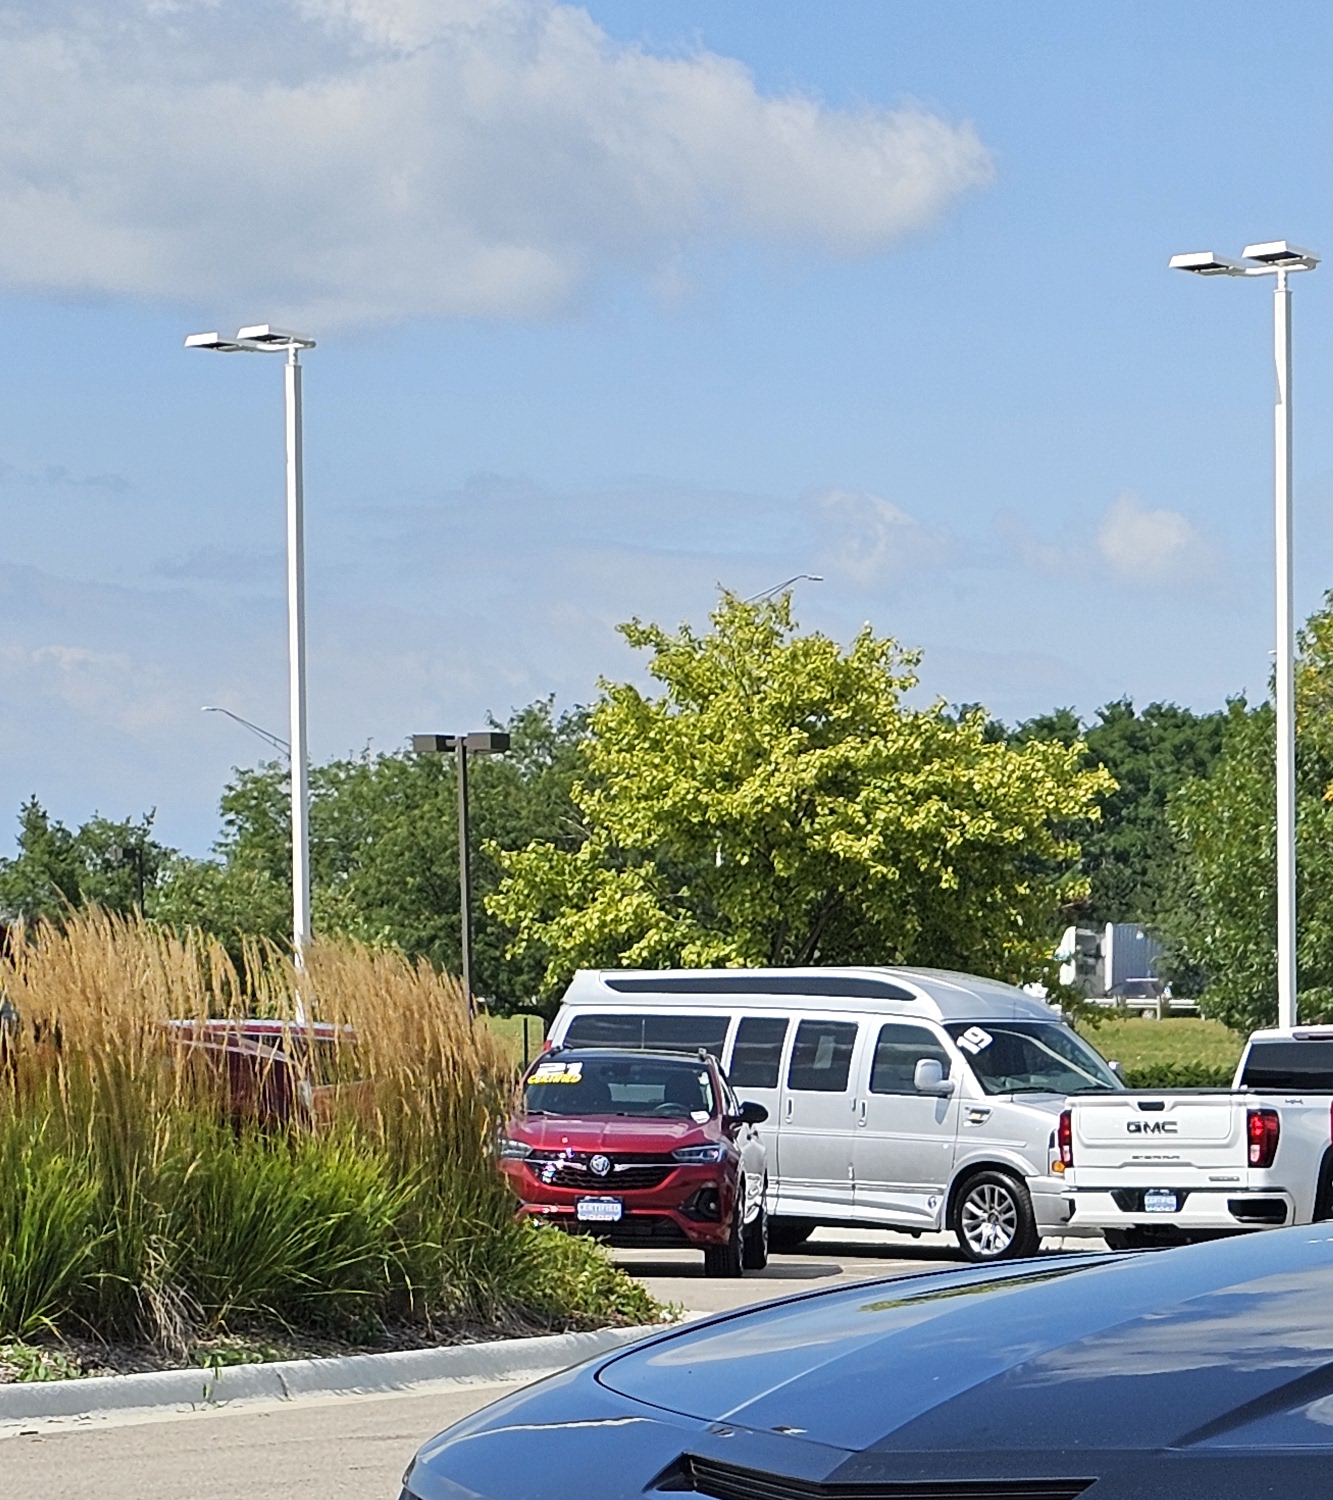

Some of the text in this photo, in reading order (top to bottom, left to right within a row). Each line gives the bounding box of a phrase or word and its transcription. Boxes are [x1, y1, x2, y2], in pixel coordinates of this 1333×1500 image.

[956, 1025, 993, 1055] 19
[536, 1061, 583, 1075] 21
[1126, 1121, 1179, 1134] GMC
